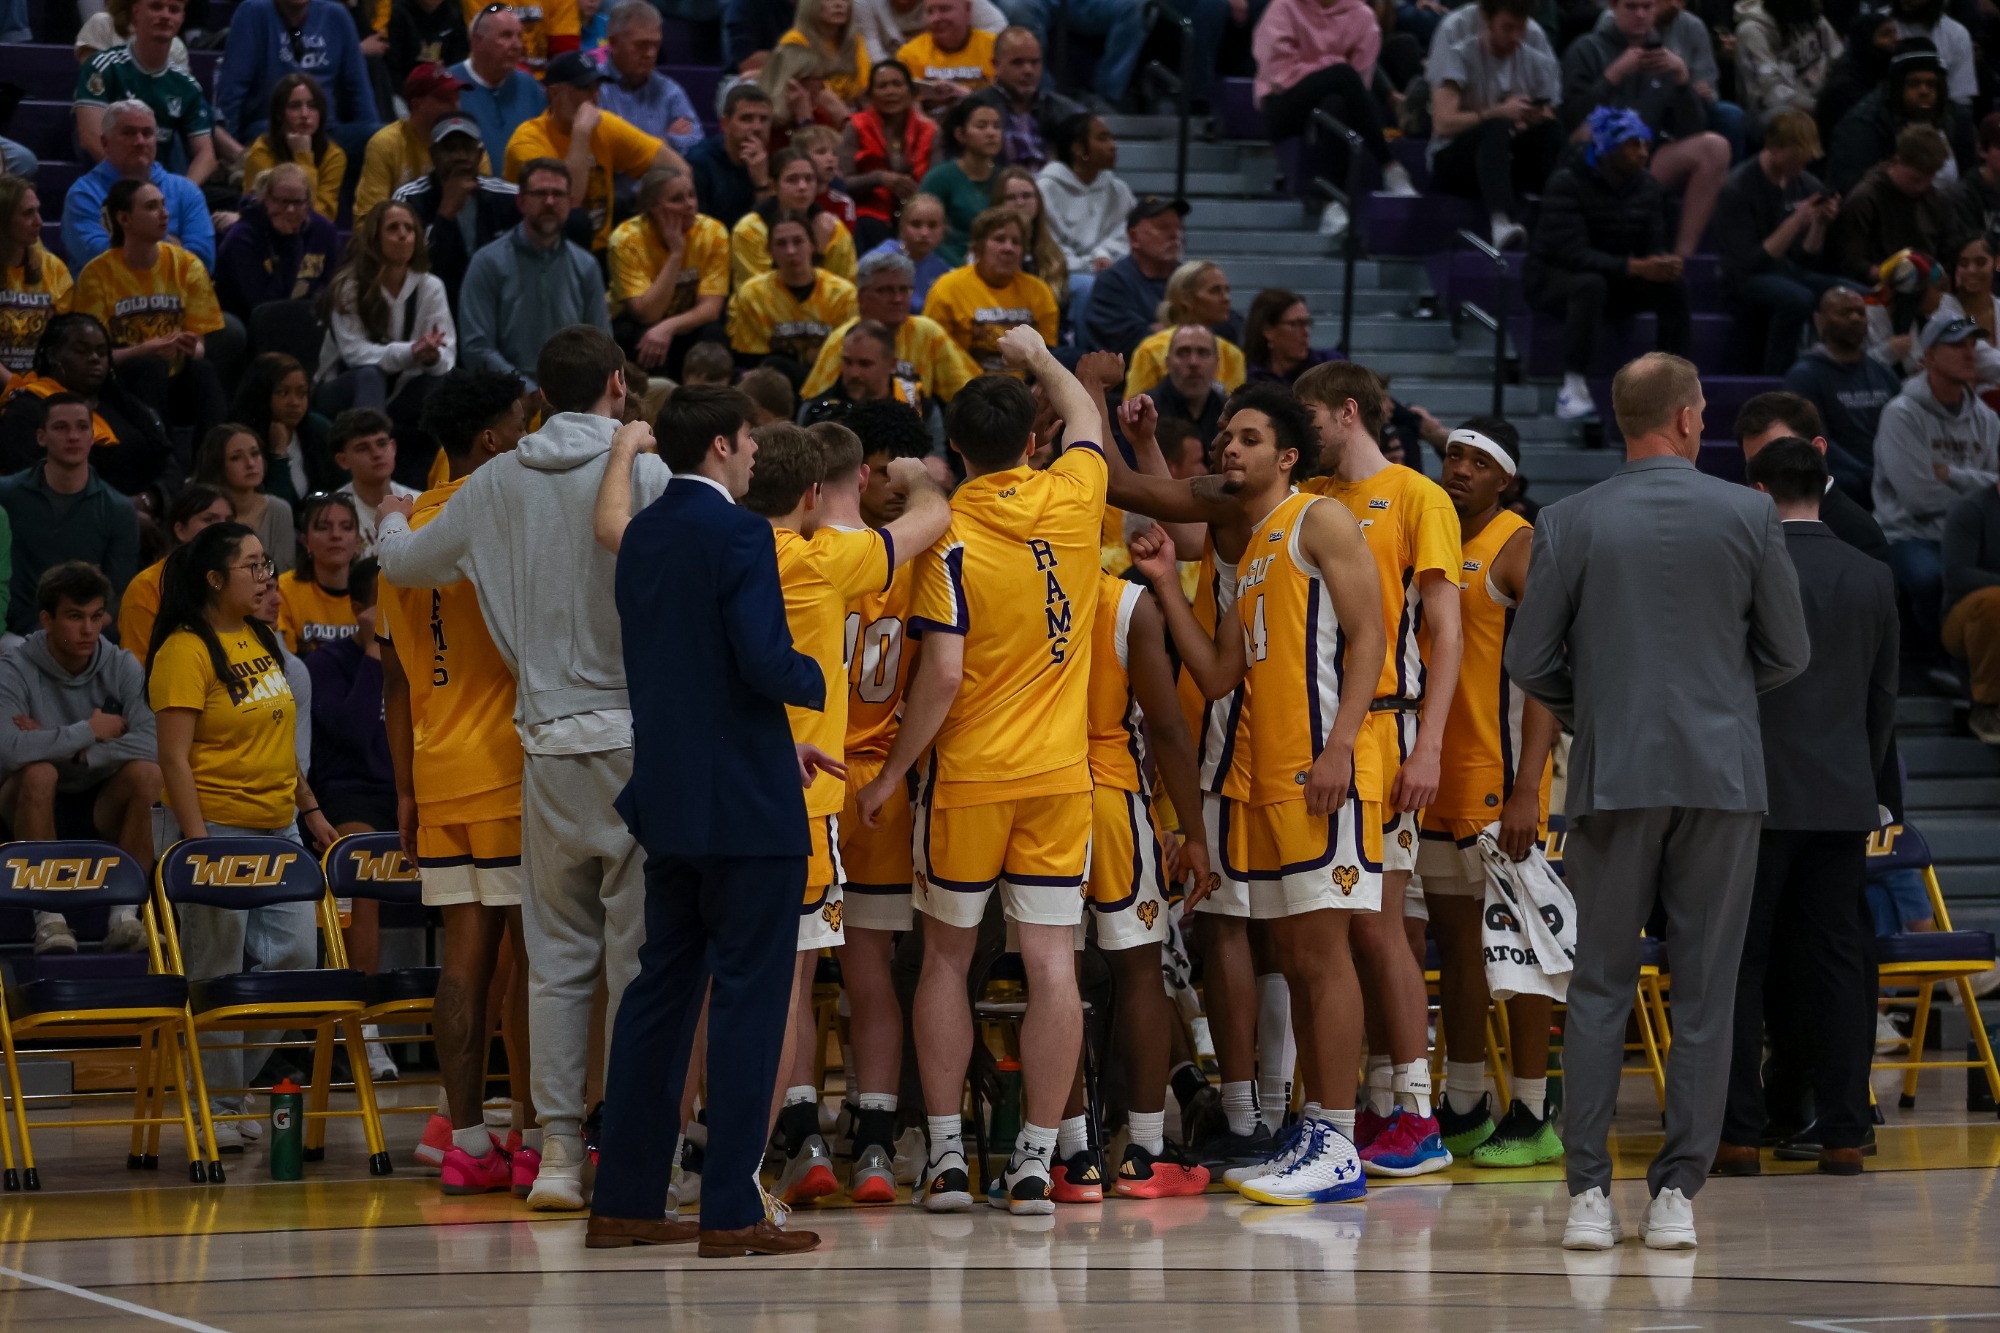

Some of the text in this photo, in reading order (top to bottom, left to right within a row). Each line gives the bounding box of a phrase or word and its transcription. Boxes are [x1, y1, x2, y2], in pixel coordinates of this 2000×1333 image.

[115, 293, 180, 317] GOLD OUT
[1369, 499, 1389, 508] PSAC
[1269, 529, 1285, 540] PSAC
[1463, 561, 1481, 569] PSAC
[1026, 539, 1072, 664] RAMS
[303, 624, 360, 642] GOLD OU
[430, 588, 448, 687] AMS
[227, 671, 294, 707] RAM
[7, 857, 120, 891] WCU
[186, 853, 297, 887] WCU
[349, 850, 422, 882] WC
